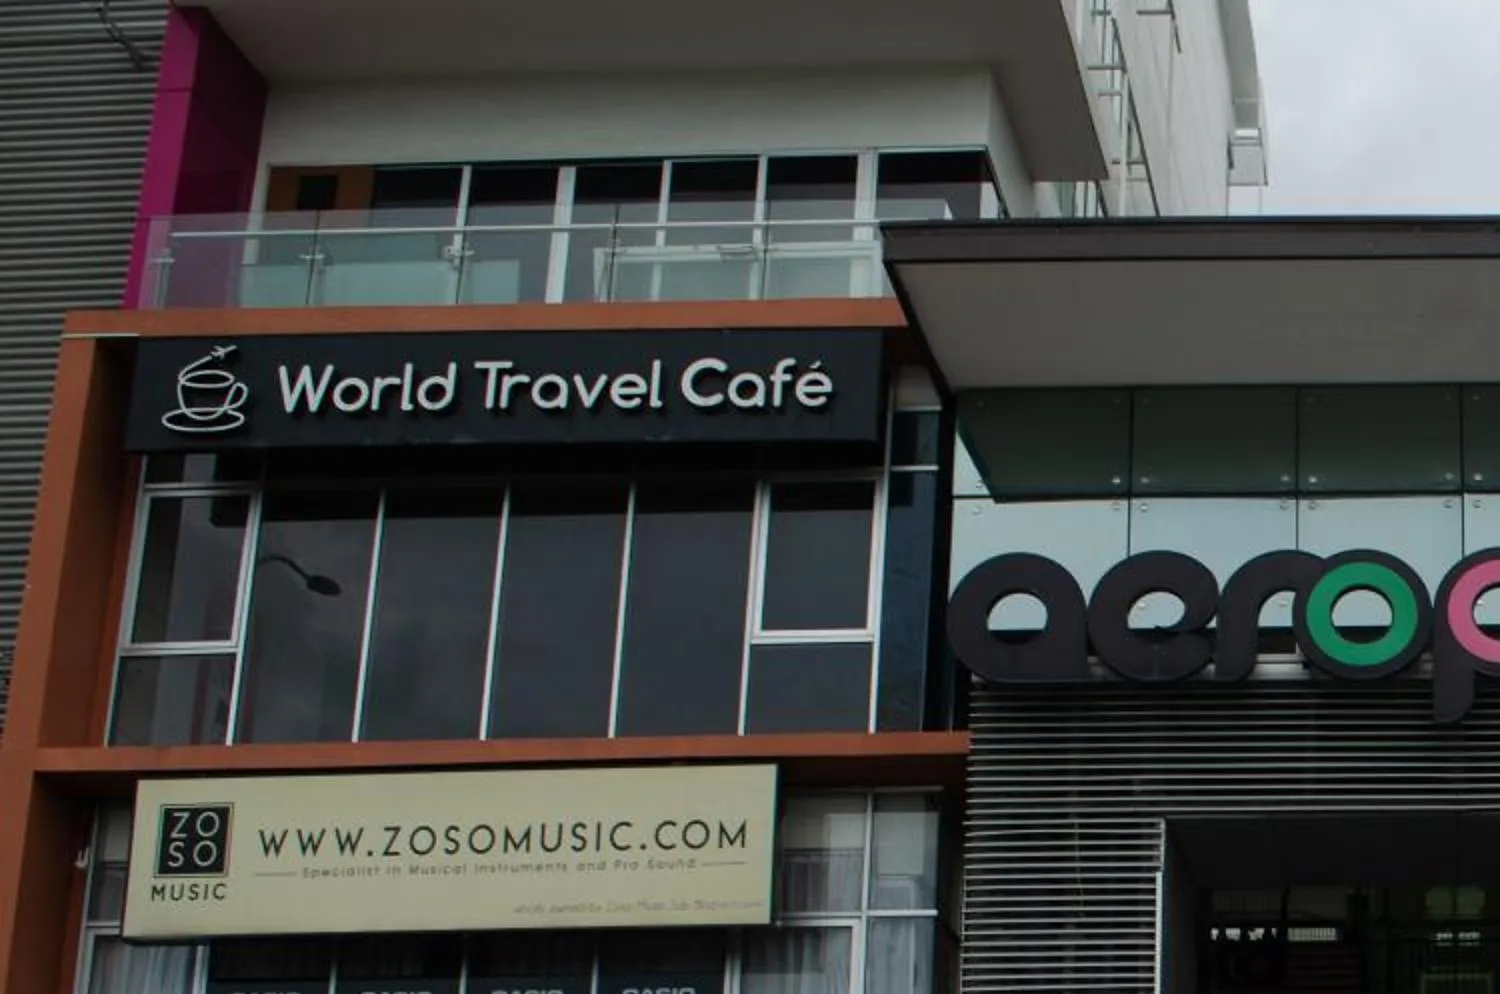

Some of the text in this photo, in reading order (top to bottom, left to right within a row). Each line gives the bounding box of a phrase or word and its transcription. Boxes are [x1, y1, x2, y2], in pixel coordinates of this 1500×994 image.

[277, 357, 834, 414] World Travel Café
[170, 811, 221, 838] ZO
[258, 820, 748, 858] WWW.ZOSOMUSIC.COM
[167, 840, 218, 868] SO
[409, 863, 467, 877] Musical
[576, 860, 607, 872] and
[614, 859, 639, 871] Pro
[151, 883, 228, 902] MUSIC
